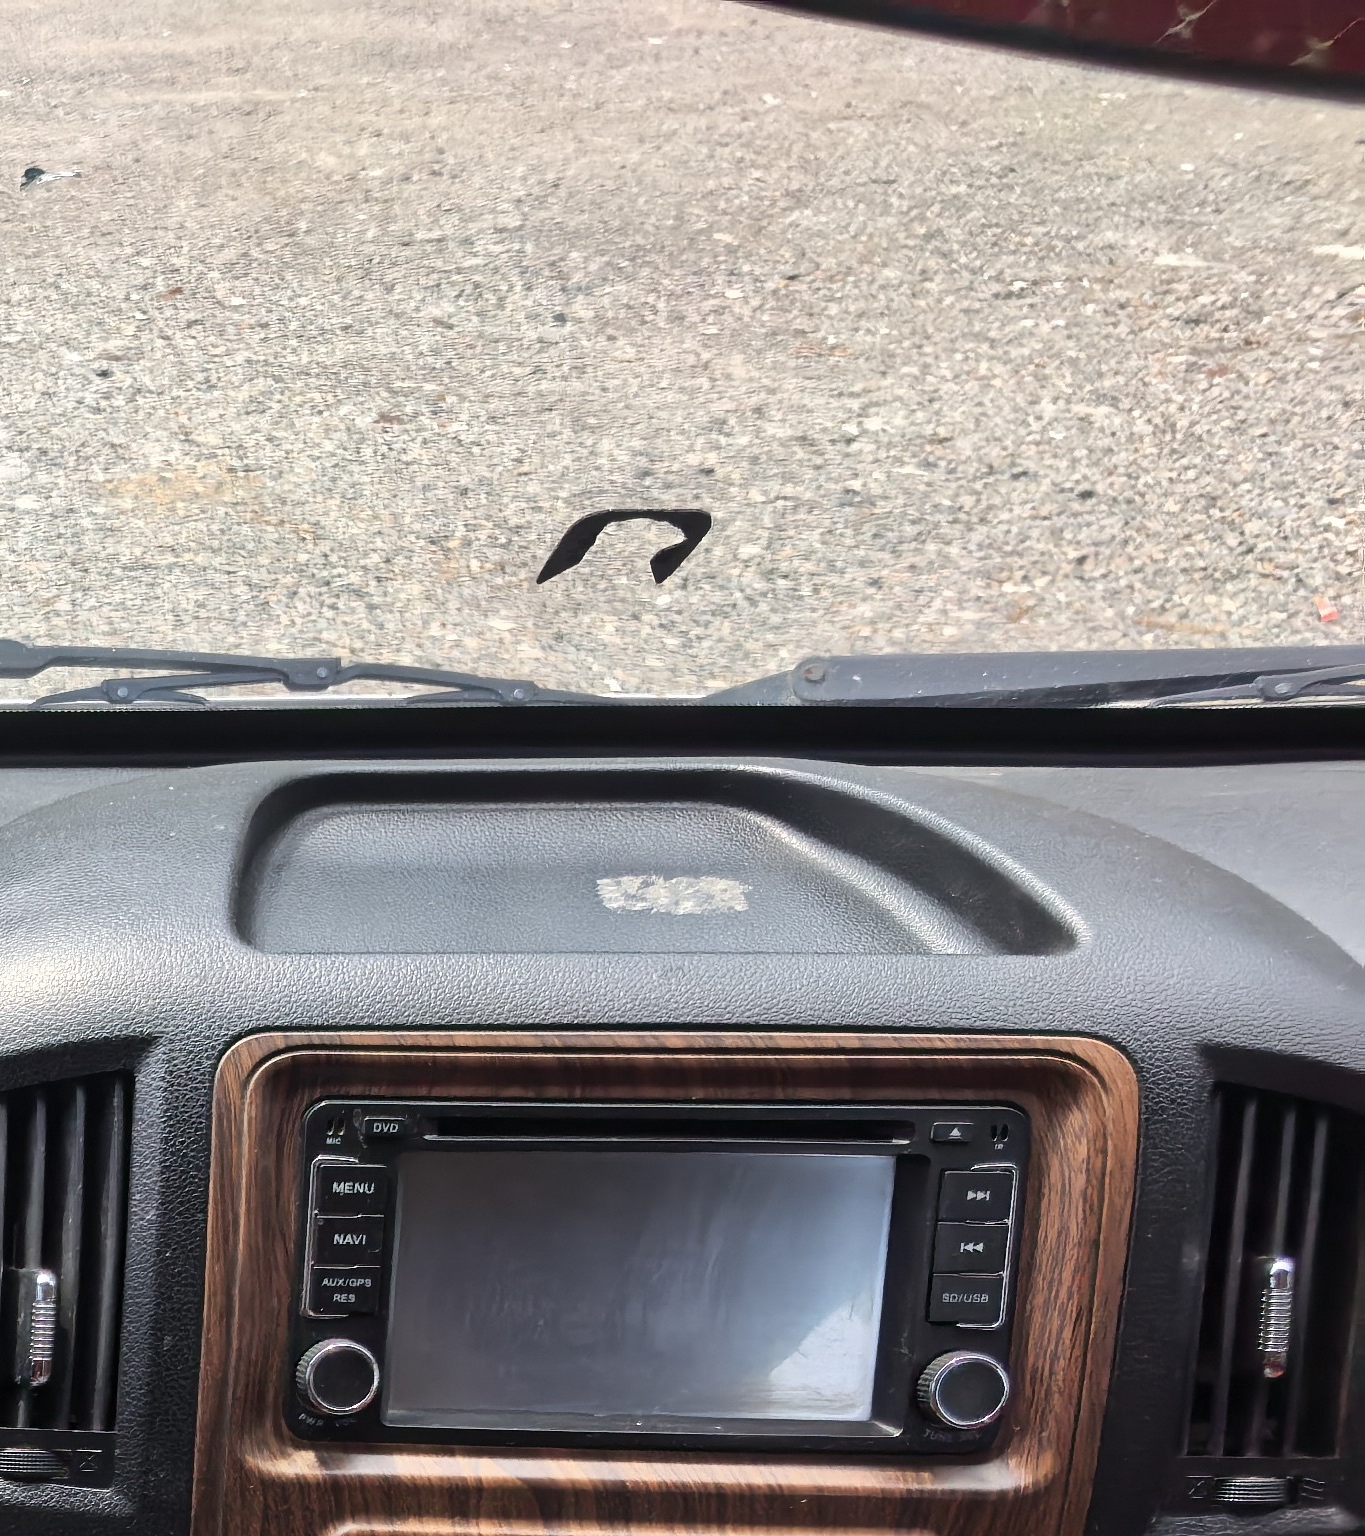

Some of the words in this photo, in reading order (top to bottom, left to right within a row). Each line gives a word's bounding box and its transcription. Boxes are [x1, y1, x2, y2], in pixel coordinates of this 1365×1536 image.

[373, 1123, 399, 1134] DVD
[332, 1181, 375, 1195] MENU
[333, 1233, 366, 1246] NAVI
[321, 1277, 372, 1288] AUX/GPS
[333, 1293, 355, 1303] RES
[942, 1293, 989, 1304] SD/USB
